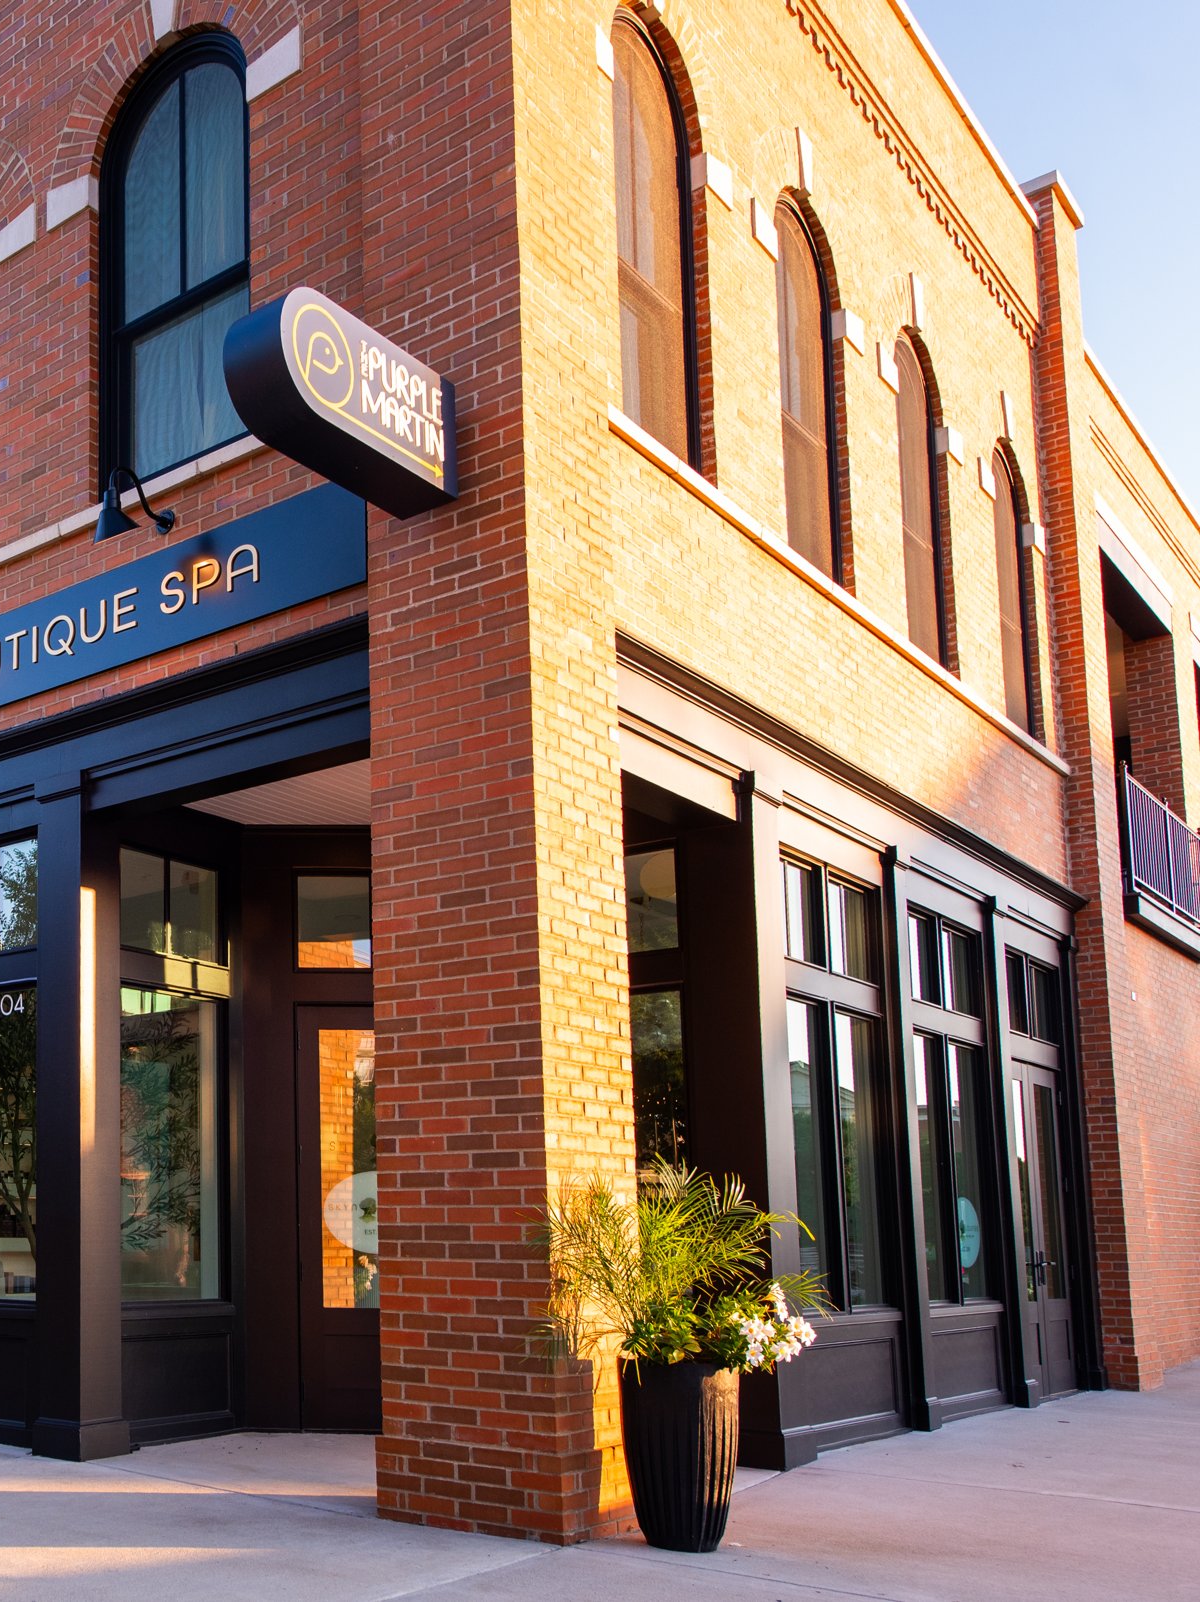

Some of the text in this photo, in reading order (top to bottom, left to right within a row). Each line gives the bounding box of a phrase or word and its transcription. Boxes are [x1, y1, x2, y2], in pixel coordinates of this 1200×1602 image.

[360, 339, 368, 377] THE
[368, 346, 443, 426] PURPLE
[361, 379, 445, 462] MARTIN
[160, 544, 259, 614] SPA
